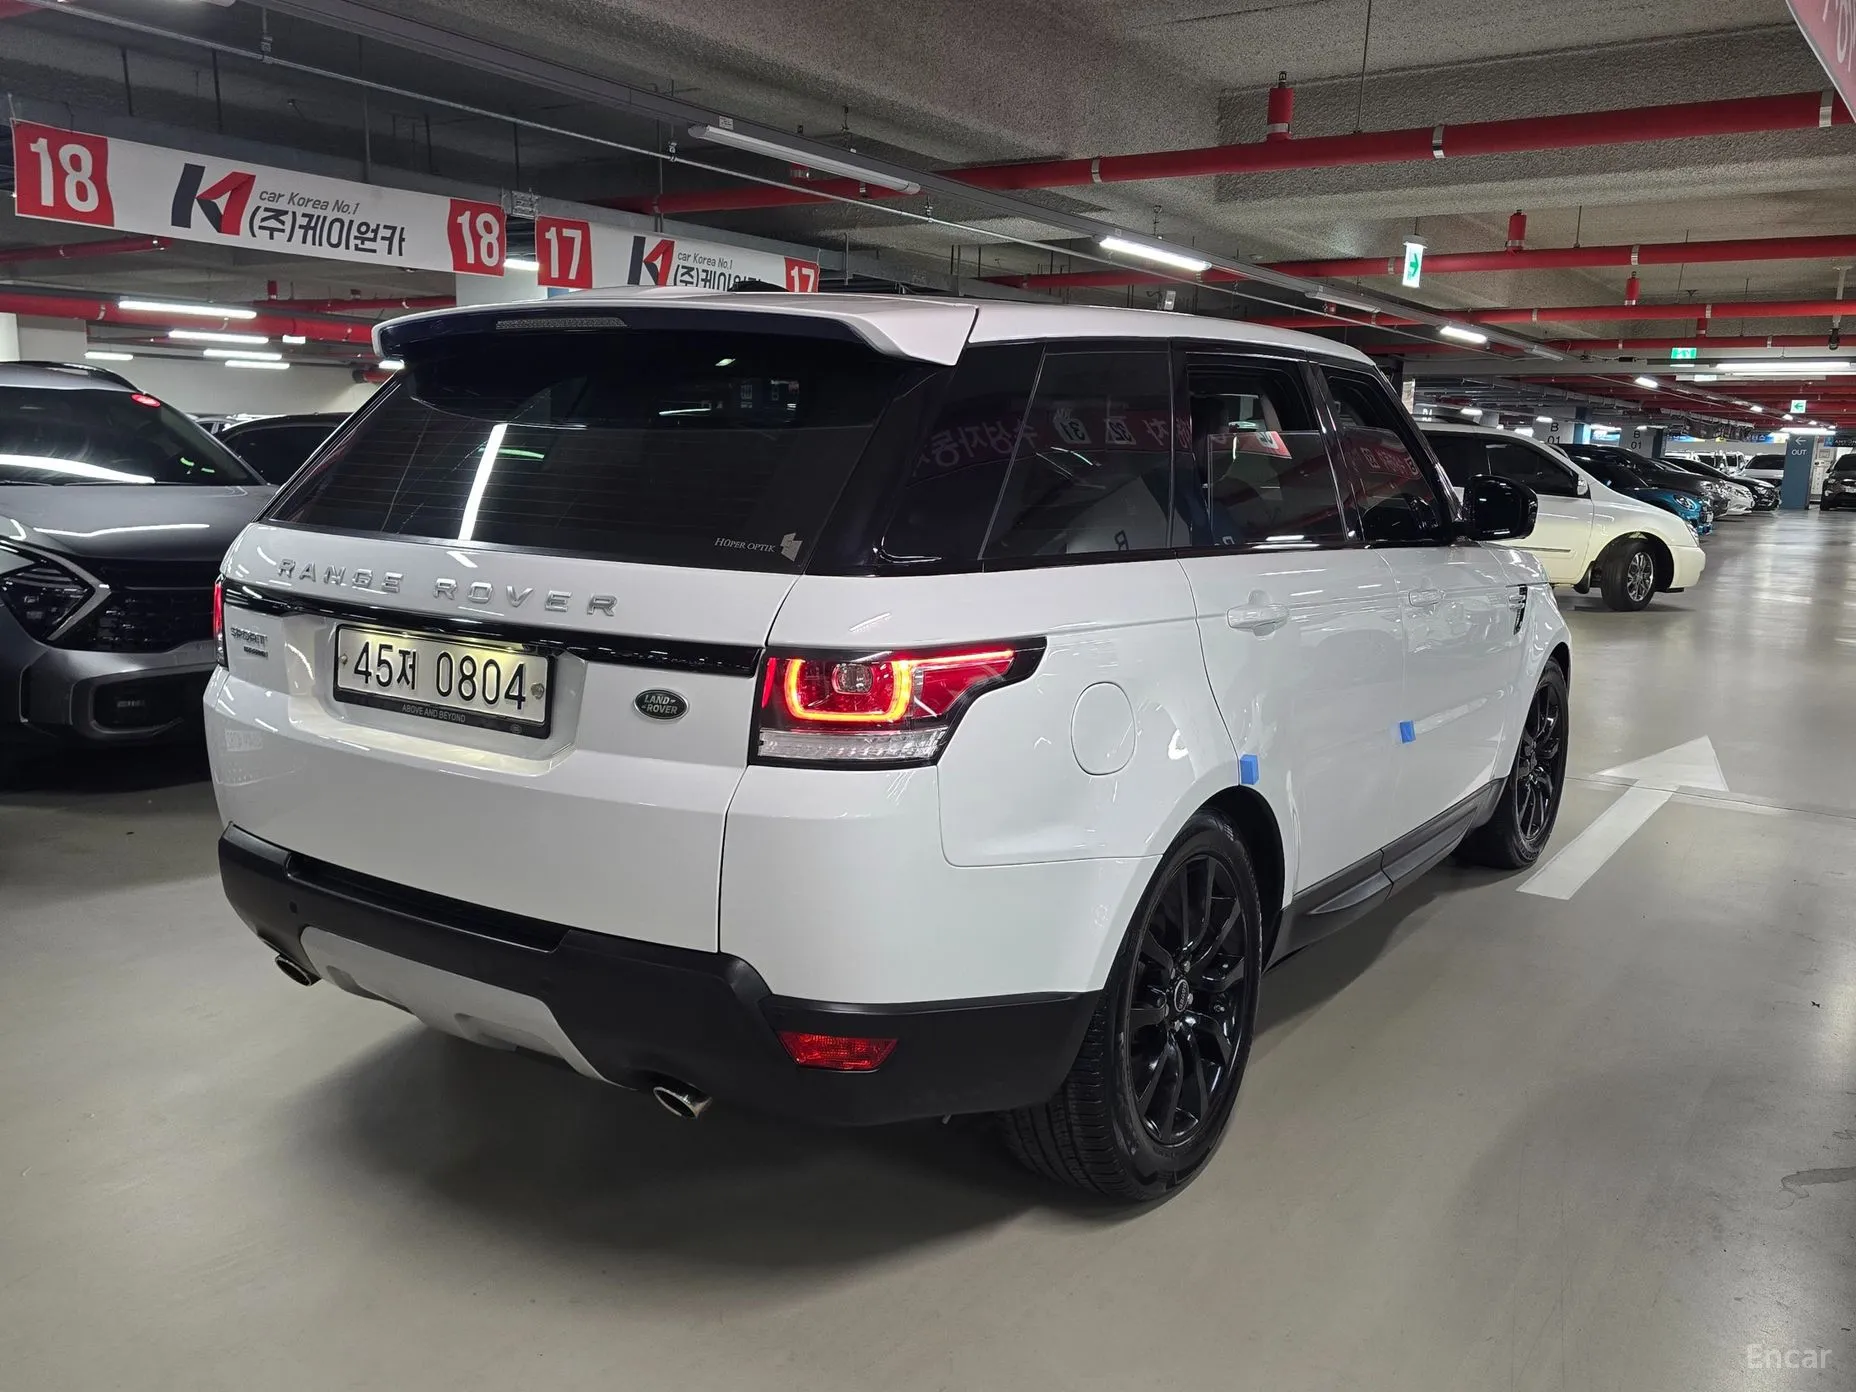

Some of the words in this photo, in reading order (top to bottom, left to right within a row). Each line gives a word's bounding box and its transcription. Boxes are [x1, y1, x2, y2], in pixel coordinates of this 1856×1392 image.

[30, 137, 99, 213] 18
[259, 190, 285, 204] car
[288, 192, 330, 211] Korea
[332, 199, 361, 215] No.1
[249, 205, 405, 257] (주)케이원카
[457, 210, 500, 267] 18
[545, 227, 582, 280] 17
[677, 251, 690, 263] car
[693, 253, 716, 267] Korea
[718, 258, 733, 270] No.1
[791, 266, 815, 293] 17
[1550, 422, 1559, 432] B
[1791, 448, 1808, 456] OUT
[747, 542, 776, 553] OPTIK
[278, 558, 404, 594] RANGE
[433, 577, 619, 617] ROVER
[354, 641, 417, 690] 45저
[436, 652, 526, 710] 0804
[644, 694, 670, 705] LAND
[646, 703, 678, 714] ROVER
[402, 704, 423, 716] ABOVE
[424, 708, 438, 718] AND
[439, 711, 466, 723] BEYOND
